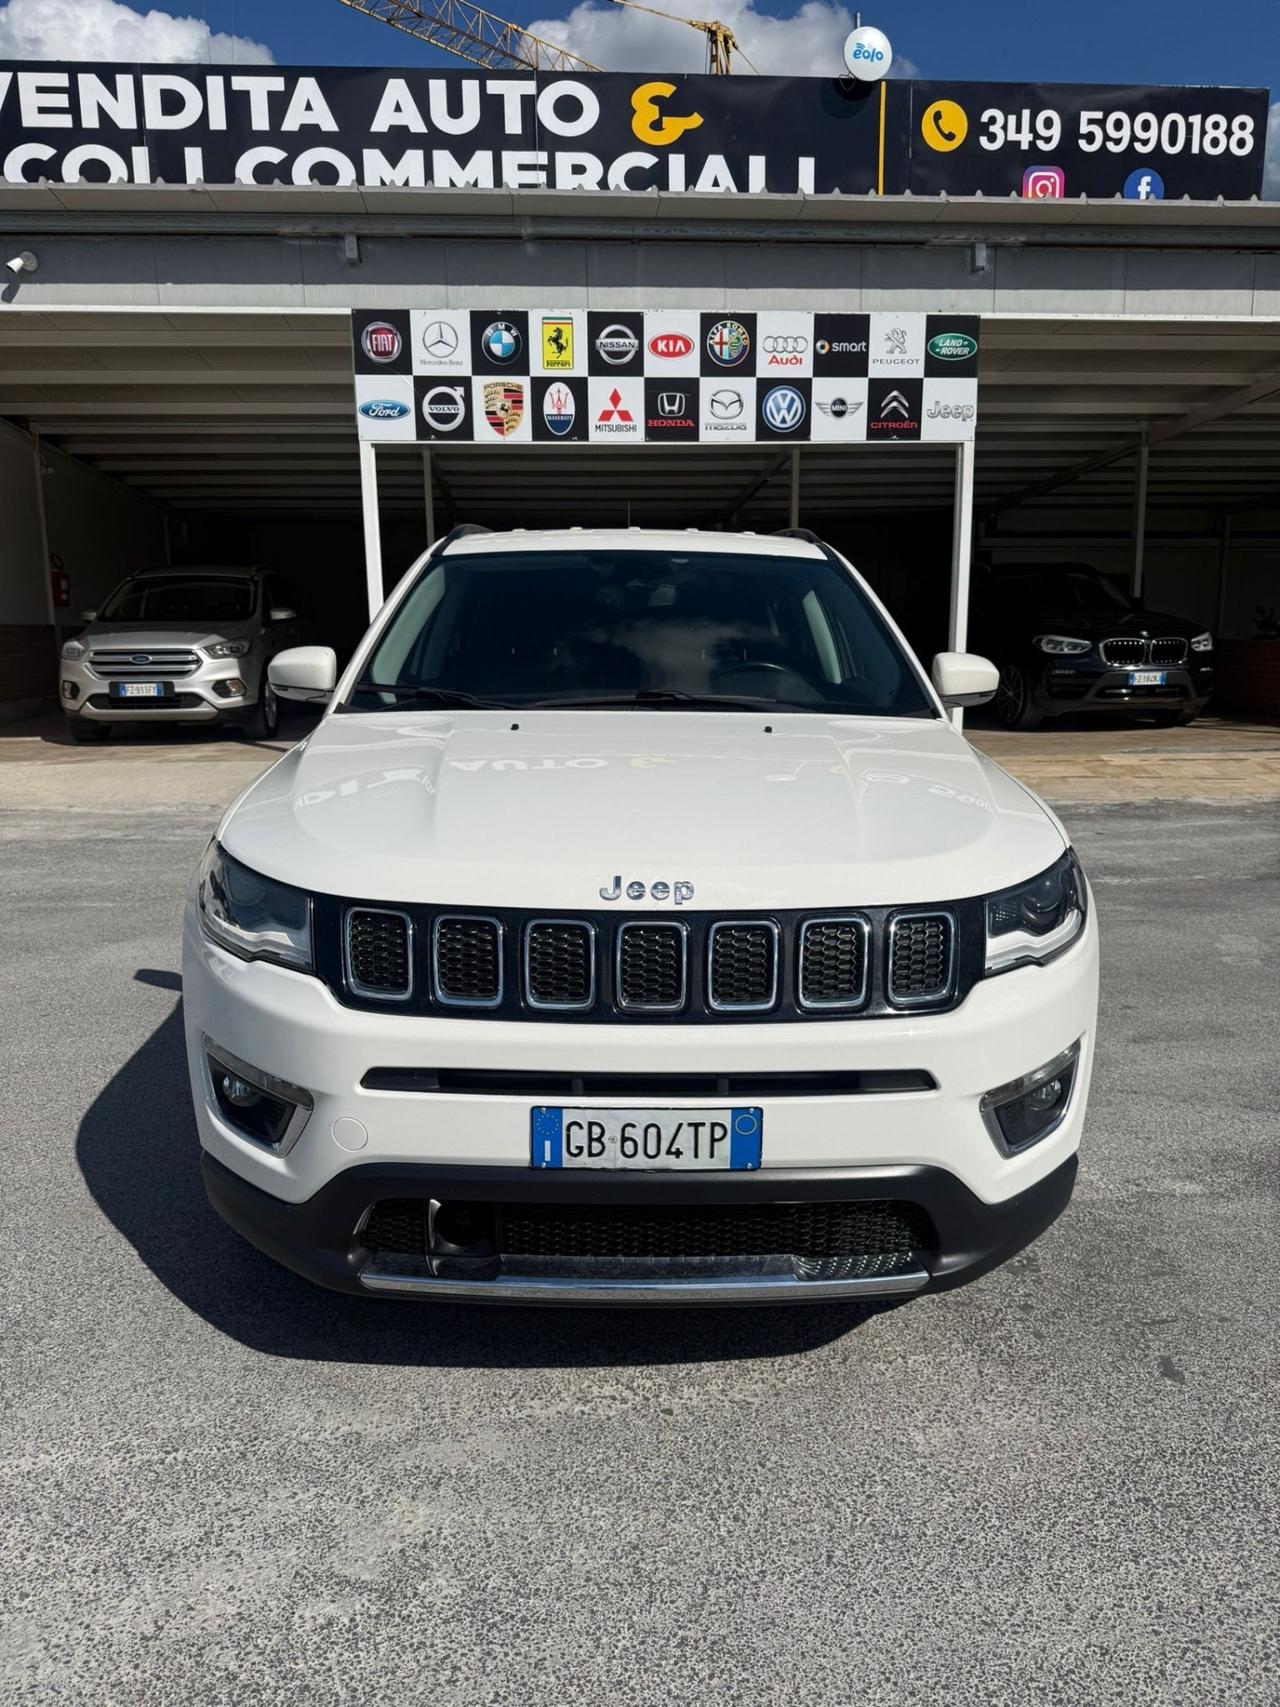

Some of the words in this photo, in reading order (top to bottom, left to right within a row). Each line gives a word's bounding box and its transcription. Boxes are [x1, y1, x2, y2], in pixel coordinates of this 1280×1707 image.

[853, 48, 884, 62] eolo
[0, 72, 339, 132] ENDITA
[370, 78, 600, 137] AUTO
[631, 82, 704, 146] &
[979, 108, 1062, 151] 349
[1077, 110, 1255, 156] 5990188
[486, 323, 519, 337] BMW
[709, 325, 723, 345] ALFA
[726, 322, 749, 345] ROMEO
[371, 334, 393, 352] FIAT
[599, 341, 636, 349] NISSAN
[657, 340, 686, 353] KIA
[832, 341, 867, 352] smart
[546, 360, 571, 368] Ferrari
[768, 355, 803, 366] Audi
[483, 382, 524, 391] PORSCHE
[368, 402, 401, 418] Ford
[831, 404, 847, 412] MINI
[927, 401, 974, 421] Jeep
[595, 424, 637, 433] MITSUBISHI
[648, 419, 695, 427] HONDA
[599, 875, 695, 906] Jeep
